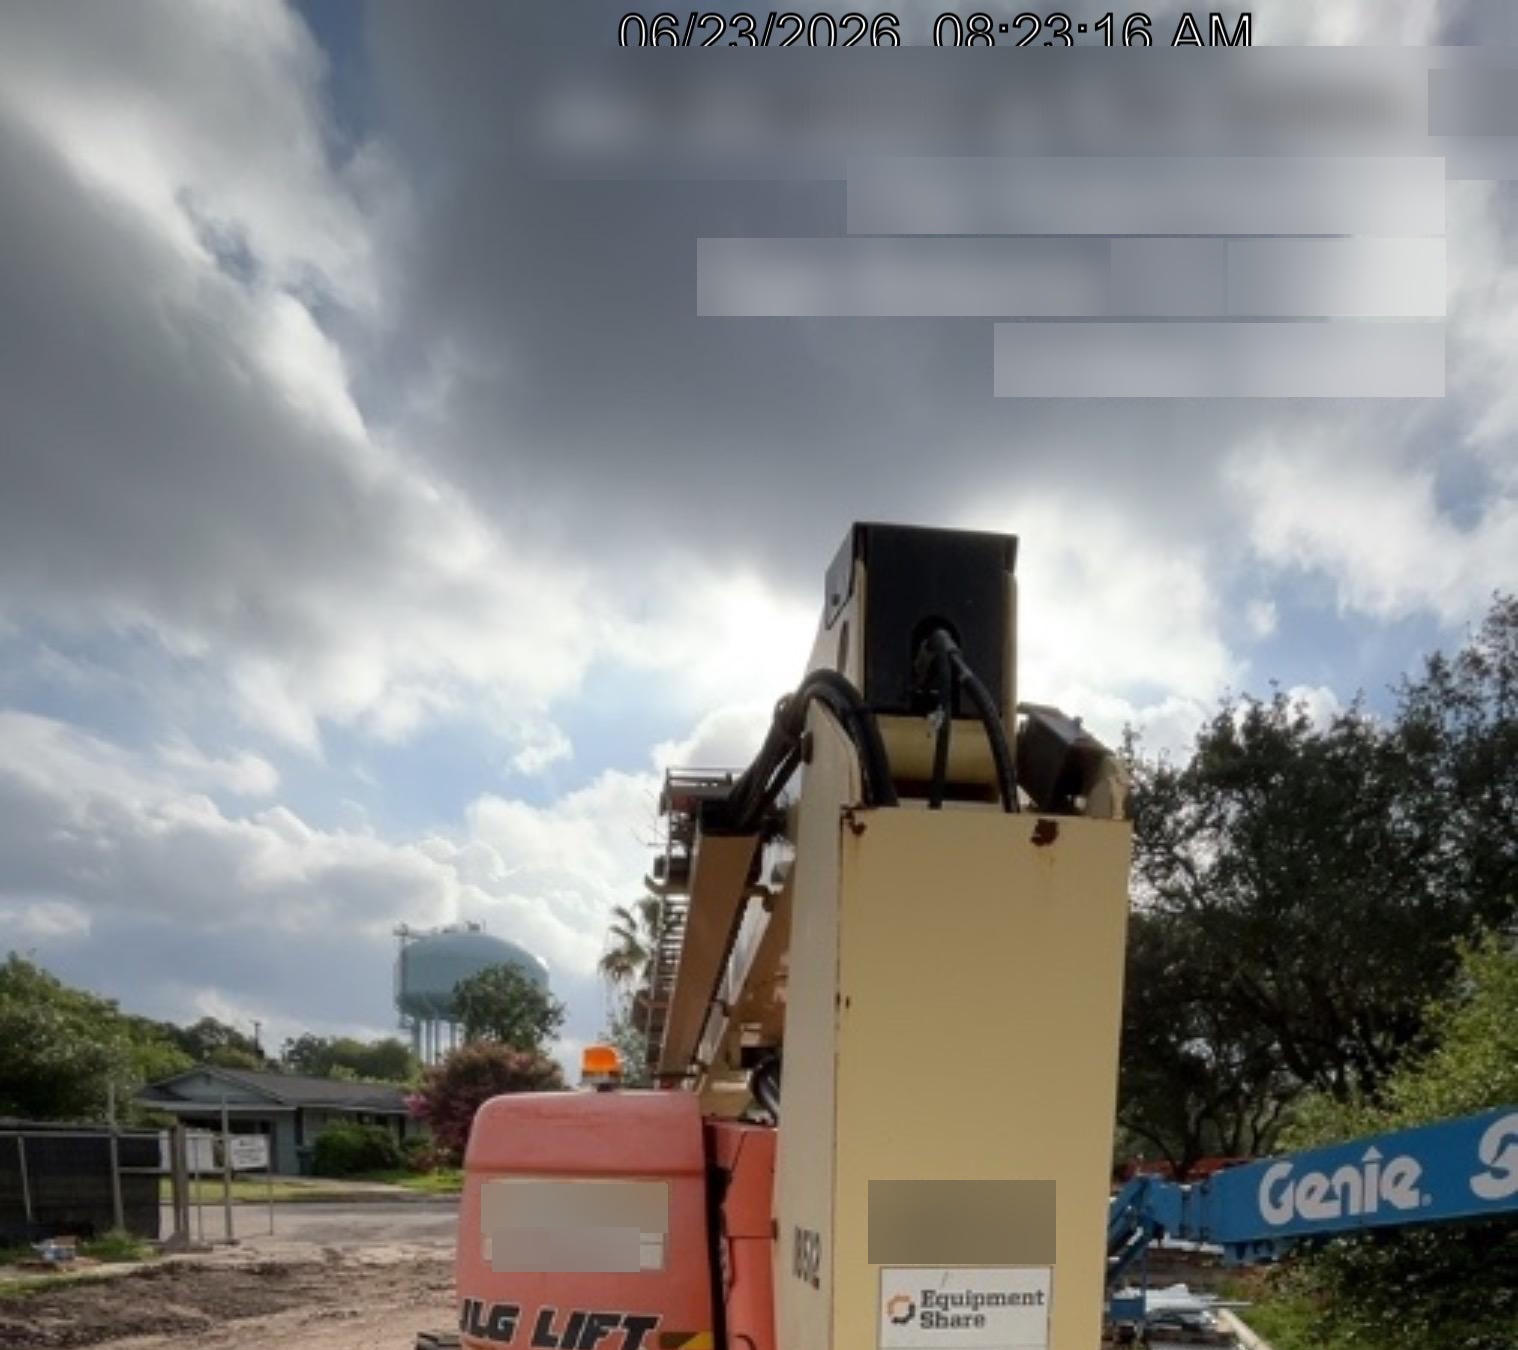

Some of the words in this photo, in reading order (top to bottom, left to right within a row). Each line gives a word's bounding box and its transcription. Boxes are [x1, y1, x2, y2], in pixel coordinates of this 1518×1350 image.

[1259, 1145, 1423, 1225] Genie
[920, 1288, 1045, 1311] Equipment
[919, 1311, 986, 1329] Share
